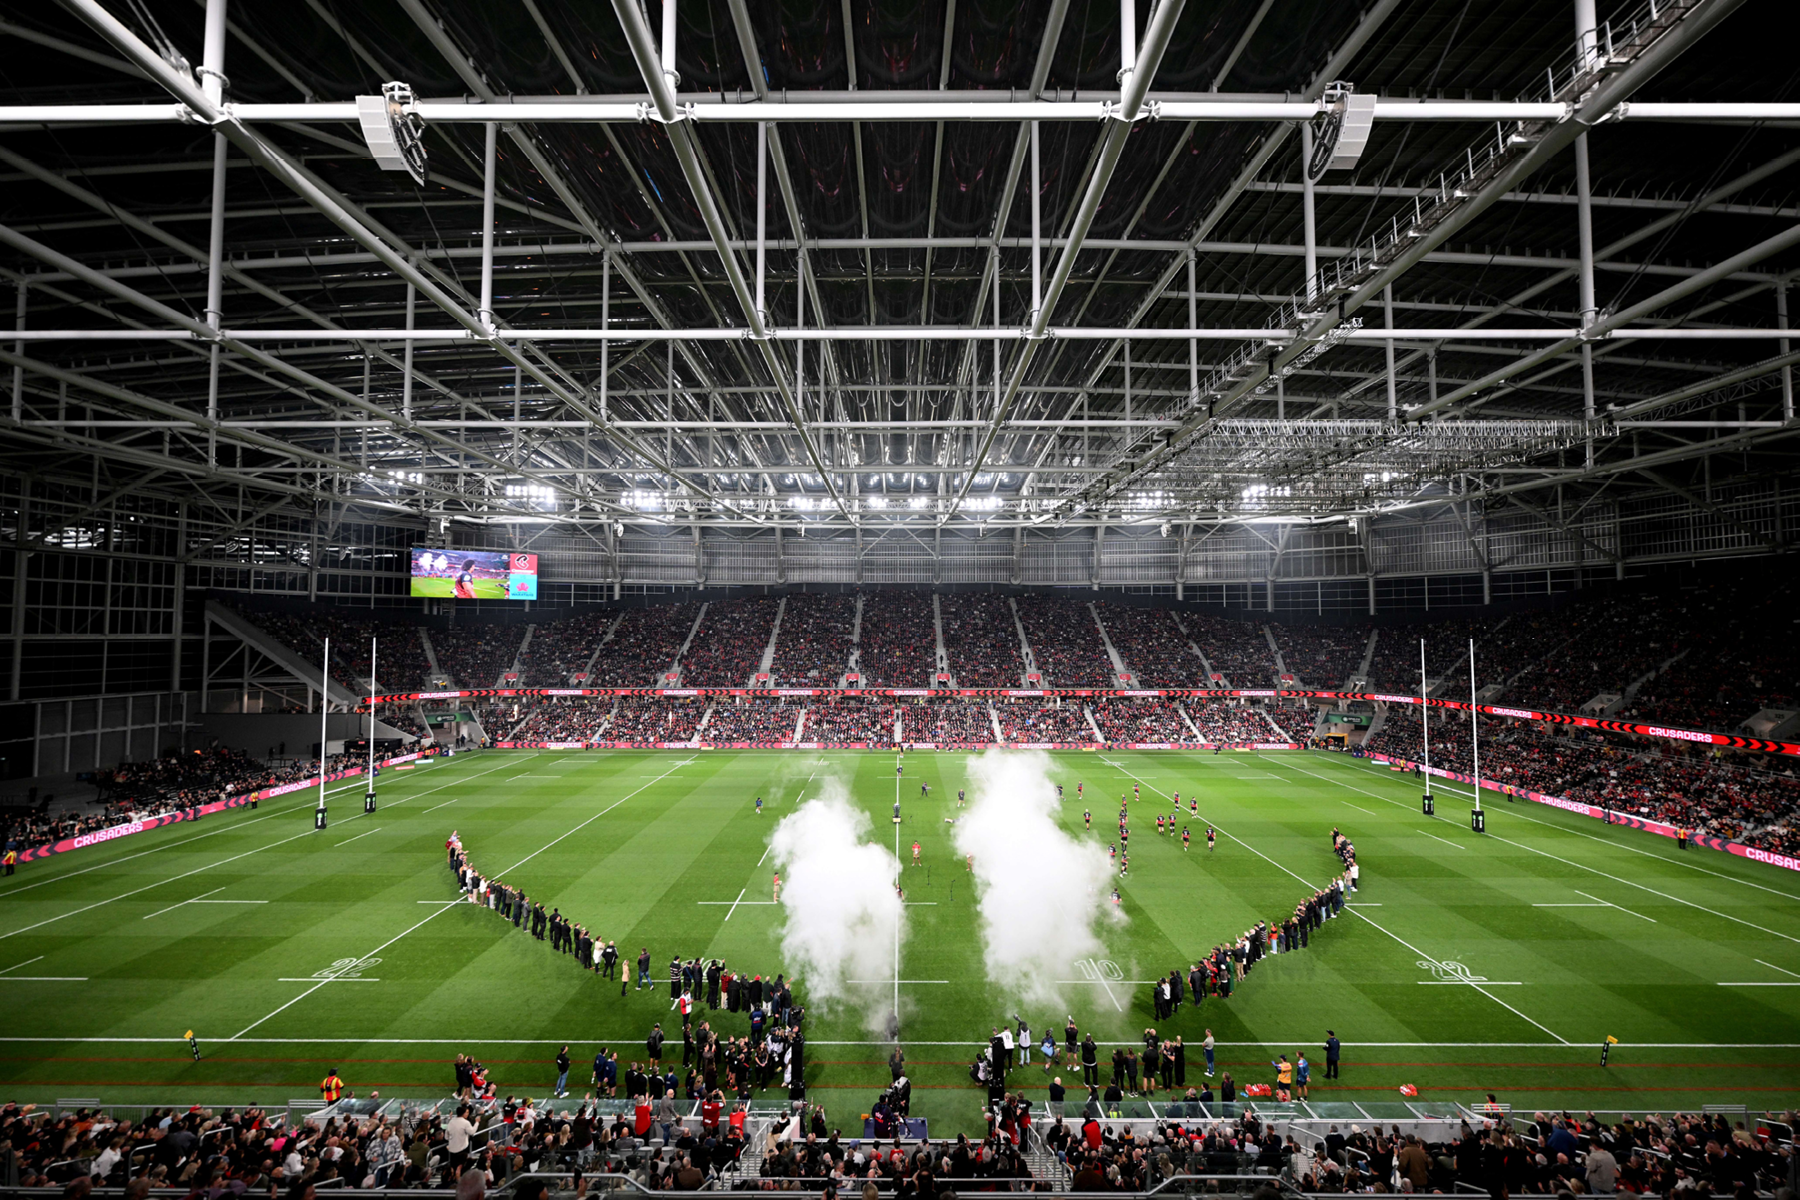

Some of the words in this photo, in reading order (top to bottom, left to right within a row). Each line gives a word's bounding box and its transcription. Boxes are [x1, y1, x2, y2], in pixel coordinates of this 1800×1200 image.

[419, 691, 460, 699] CRUSADERS
[1374, 694, 1414, 703] CRUSADERS
[1492, 707, 1532, 719] CRUSADERS
[1649, 726, 1713, 743] CRUSADERS
[269, 779, 311, 797] CRUSADERS
[1540, 795, 1590, 815] CRUSADERS
[74, 822, 143, 848] CRUSADERS
[1074, 960, 1124, 980] 10
